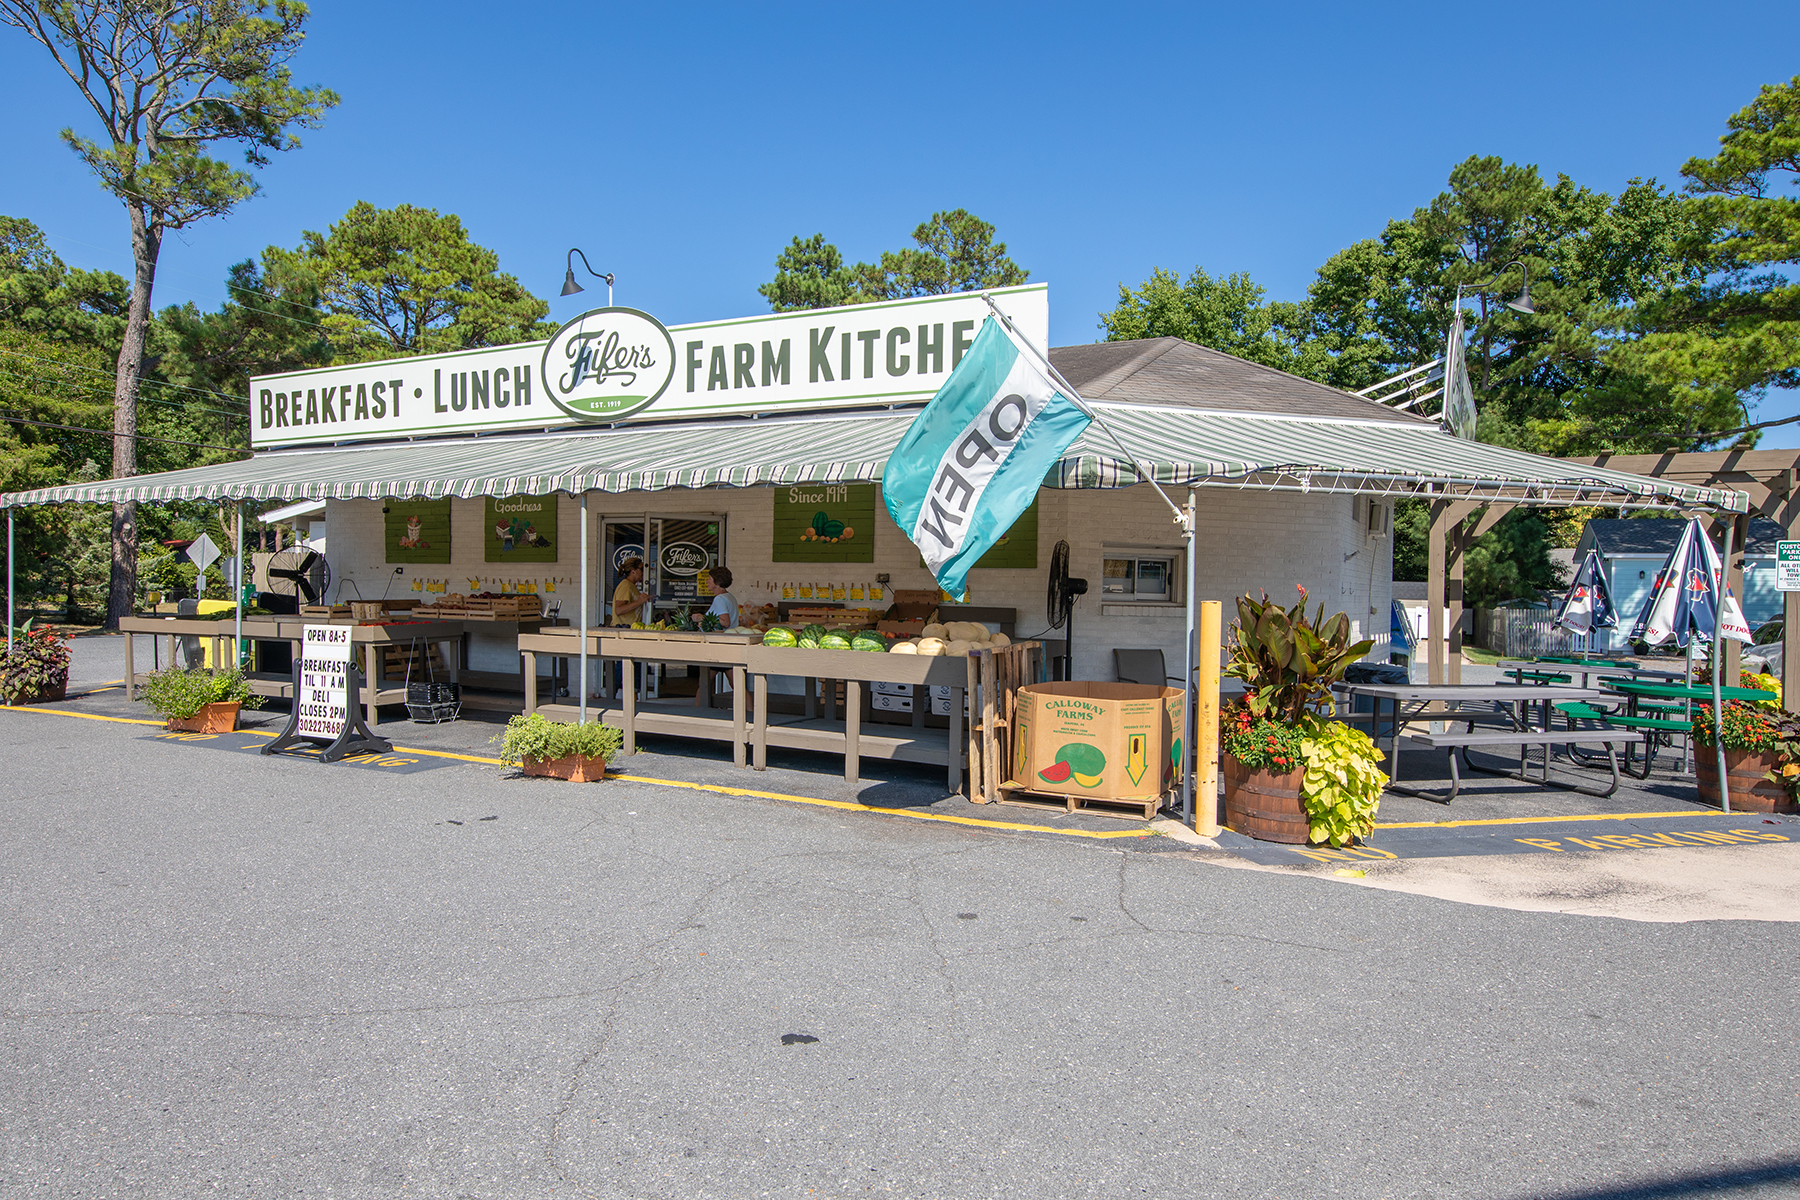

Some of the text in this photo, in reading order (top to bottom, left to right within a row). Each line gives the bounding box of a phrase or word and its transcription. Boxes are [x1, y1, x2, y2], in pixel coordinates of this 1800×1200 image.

[559, 329, 656, 394] Fifer's
[686, 316, 1012, 393] FARM KITCHE
[260, 365, 531, 429] BREAKFAST LUNCH
[789, 485, 848, 504] Since 1919
[494, 497, 542, 513] Goodness
[307, 629, 326, 642] OPEN
[304, 659, 346, 674] BREAKFAST
[305, 674, 315, 687] TIL
[312, 690, 330, 703] DELI
[299, 704, 345, 720] CLOSES 2PM
[1045, 700, 1106, 716] CALLOWAY
[1056, 709, 1094, 721] FARMS
[1514, 829, 1790, 852] PARKING
